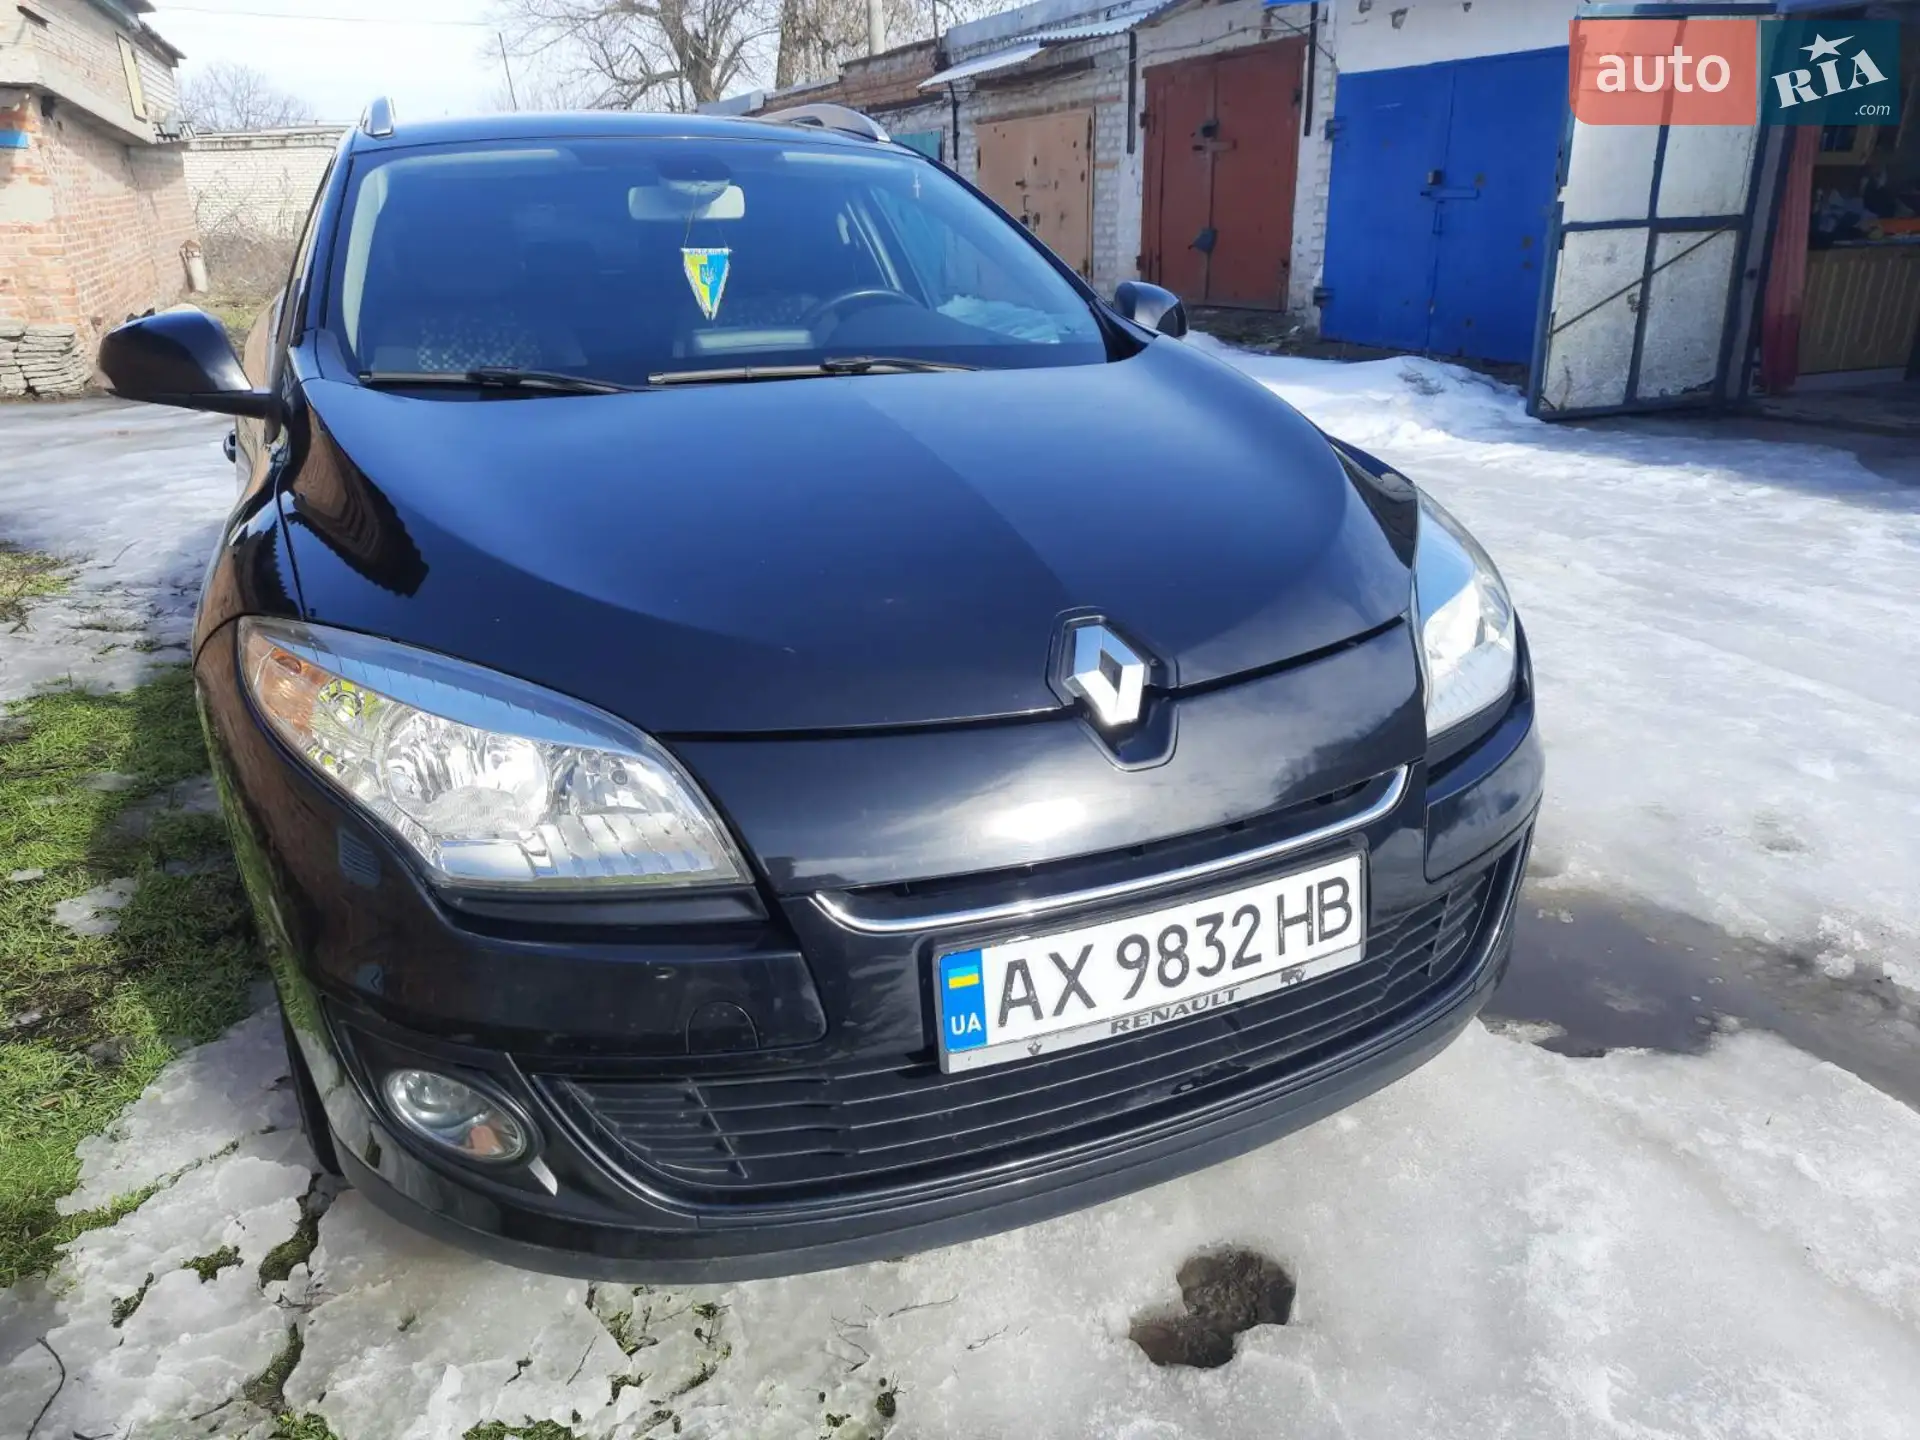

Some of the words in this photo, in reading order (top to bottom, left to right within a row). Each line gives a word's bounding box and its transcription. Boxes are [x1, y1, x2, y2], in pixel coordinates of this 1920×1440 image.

[997, 944, 1096, 1028] AX
[1116, 903, 1262, 1001] 9832
[1276, 876, 1353, 956] HB
[951, 1014, 982, 1036] UA
[1110, 988, 1241, 1035] RENAULT
